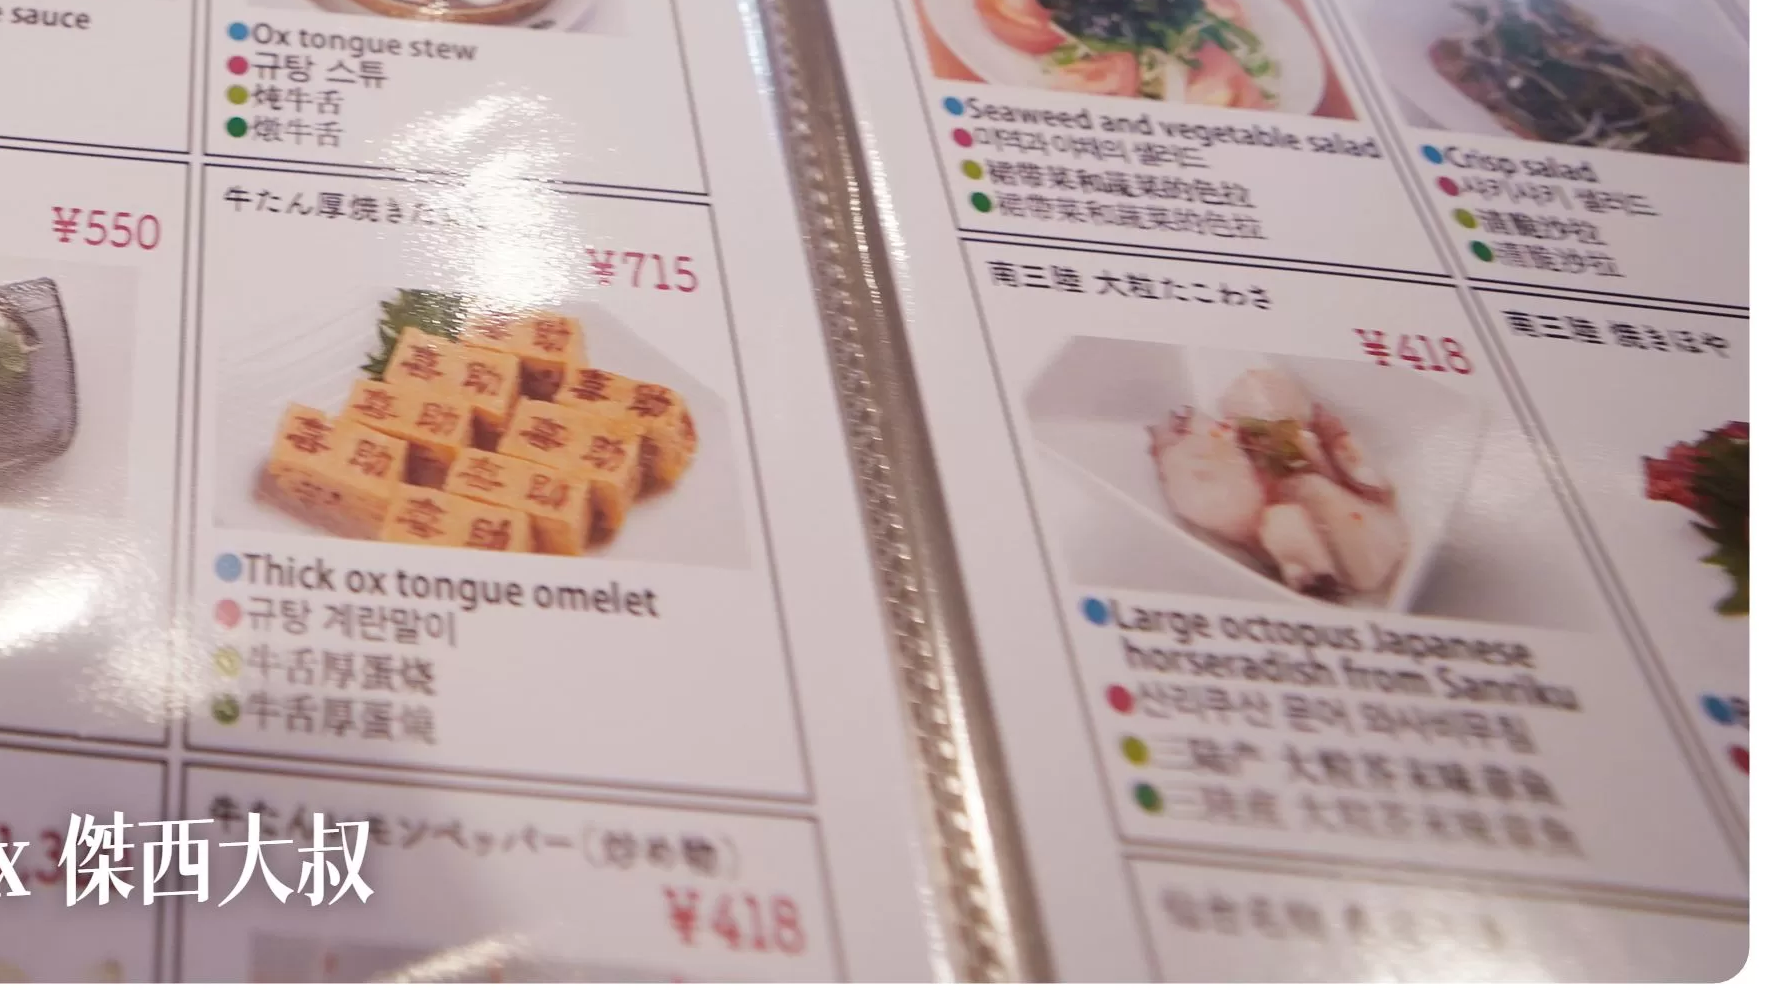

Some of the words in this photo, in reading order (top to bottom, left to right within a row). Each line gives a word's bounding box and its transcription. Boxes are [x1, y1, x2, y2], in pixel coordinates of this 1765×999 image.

[11, 4, 92, 30] sauce
[253, 22, 291, 48] Ox
[298, 29, 402, 60] tongue
[409, 35, 478, 62] stew
[248, 52, 315, 84] 규탕
[324, 57, 389, 90] 스튜
[966, 96, 1094, 131] Seaweed
[1100, 112, 1160, 138] and
[1163, 118, 1304, 153] vegetable
[1306, 133, 1385, 161] salad
[1443, 145, 1517, 177] Crisp
[1520, 155, 1602, 184] salad
[51, 206, 162, 252] ¥550
[585, 245, 700, 293] ¥715
[987, 259, 1087, 298] 南三陸
[1093, 267, 1274, 312] 大粒たこわさ
[1352, 327, 1476, 378] ¥418
[1500, 308, 1606, 347] 南三陸
[243, 553, 338, 592] Thick
[346, 567, 388, 596] ox
[397, 567, 524, 613] tongue
[532, 581, 660, 618] omelet
[245, 598, 313, 634] 규탕
[322, 601, 460, 648] 계란말이
[1111, 598, 1212, 642] Large
[1219, 610, 1363, 662] octopus
[1370, 621, 1537, 670] Japanese
[1123, 638, 1333, 687] horseradish
[1339, 656, 1433, 696] from
[1435, 665, 1585, 714] Sanriku
[660, 884, 807, 956] ¥418
